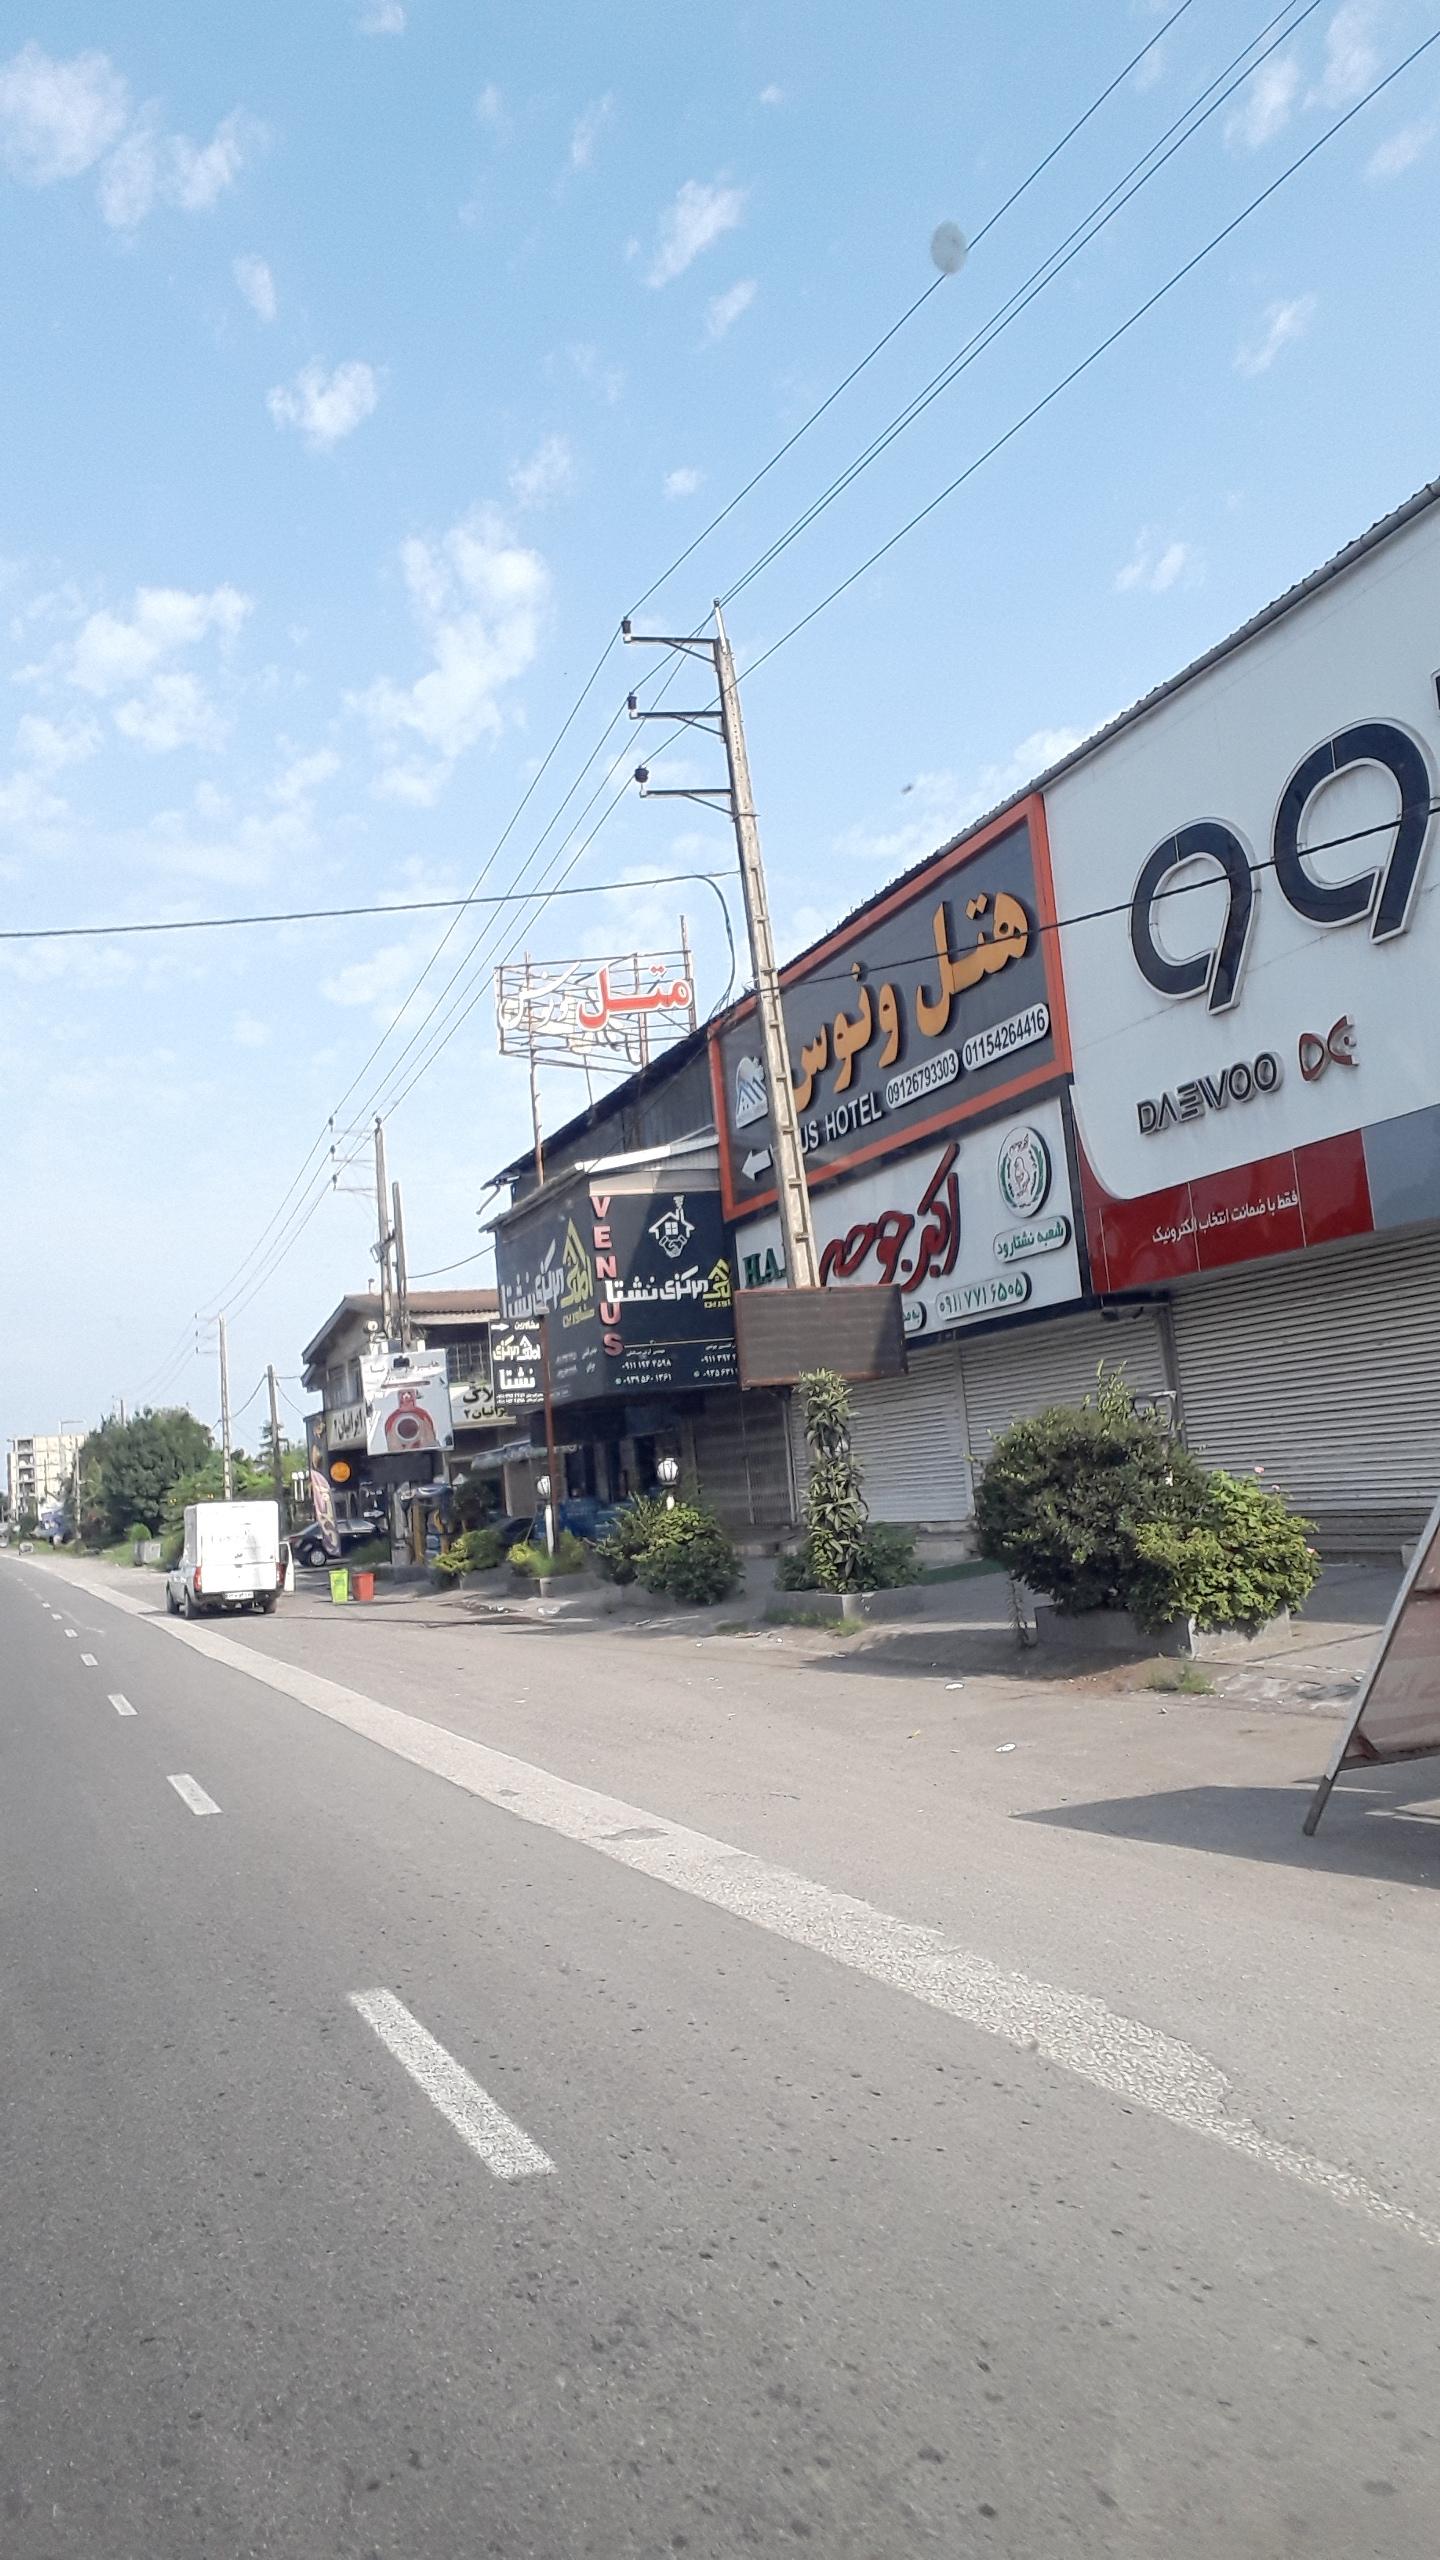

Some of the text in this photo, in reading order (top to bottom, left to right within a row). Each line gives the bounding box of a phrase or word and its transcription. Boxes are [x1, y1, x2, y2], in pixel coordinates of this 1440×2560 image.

[577, 963, 694, 1032] متل
[794, 891, 1029, 1113] هتل ونوس
[888, 1009, 1045, 1105] 09126793303 01154264416
[825, 1091, 883, 1142] HOTEL
[1136, 1050, 1284, 1135] DAEWOO
[997, 1221, 1064, 1258] شعبه نشتارود
[1152, 1189, 1299, 1245] فقط با ضمانت انتخاب الکترونیک
[590, 1196, 625, 1357] VENUS
[604, 1275, 659, 1303] نشتا
[660, 1265, 709, 1301] مرکزی
[499, 1366, 535, 1390] نشتا
